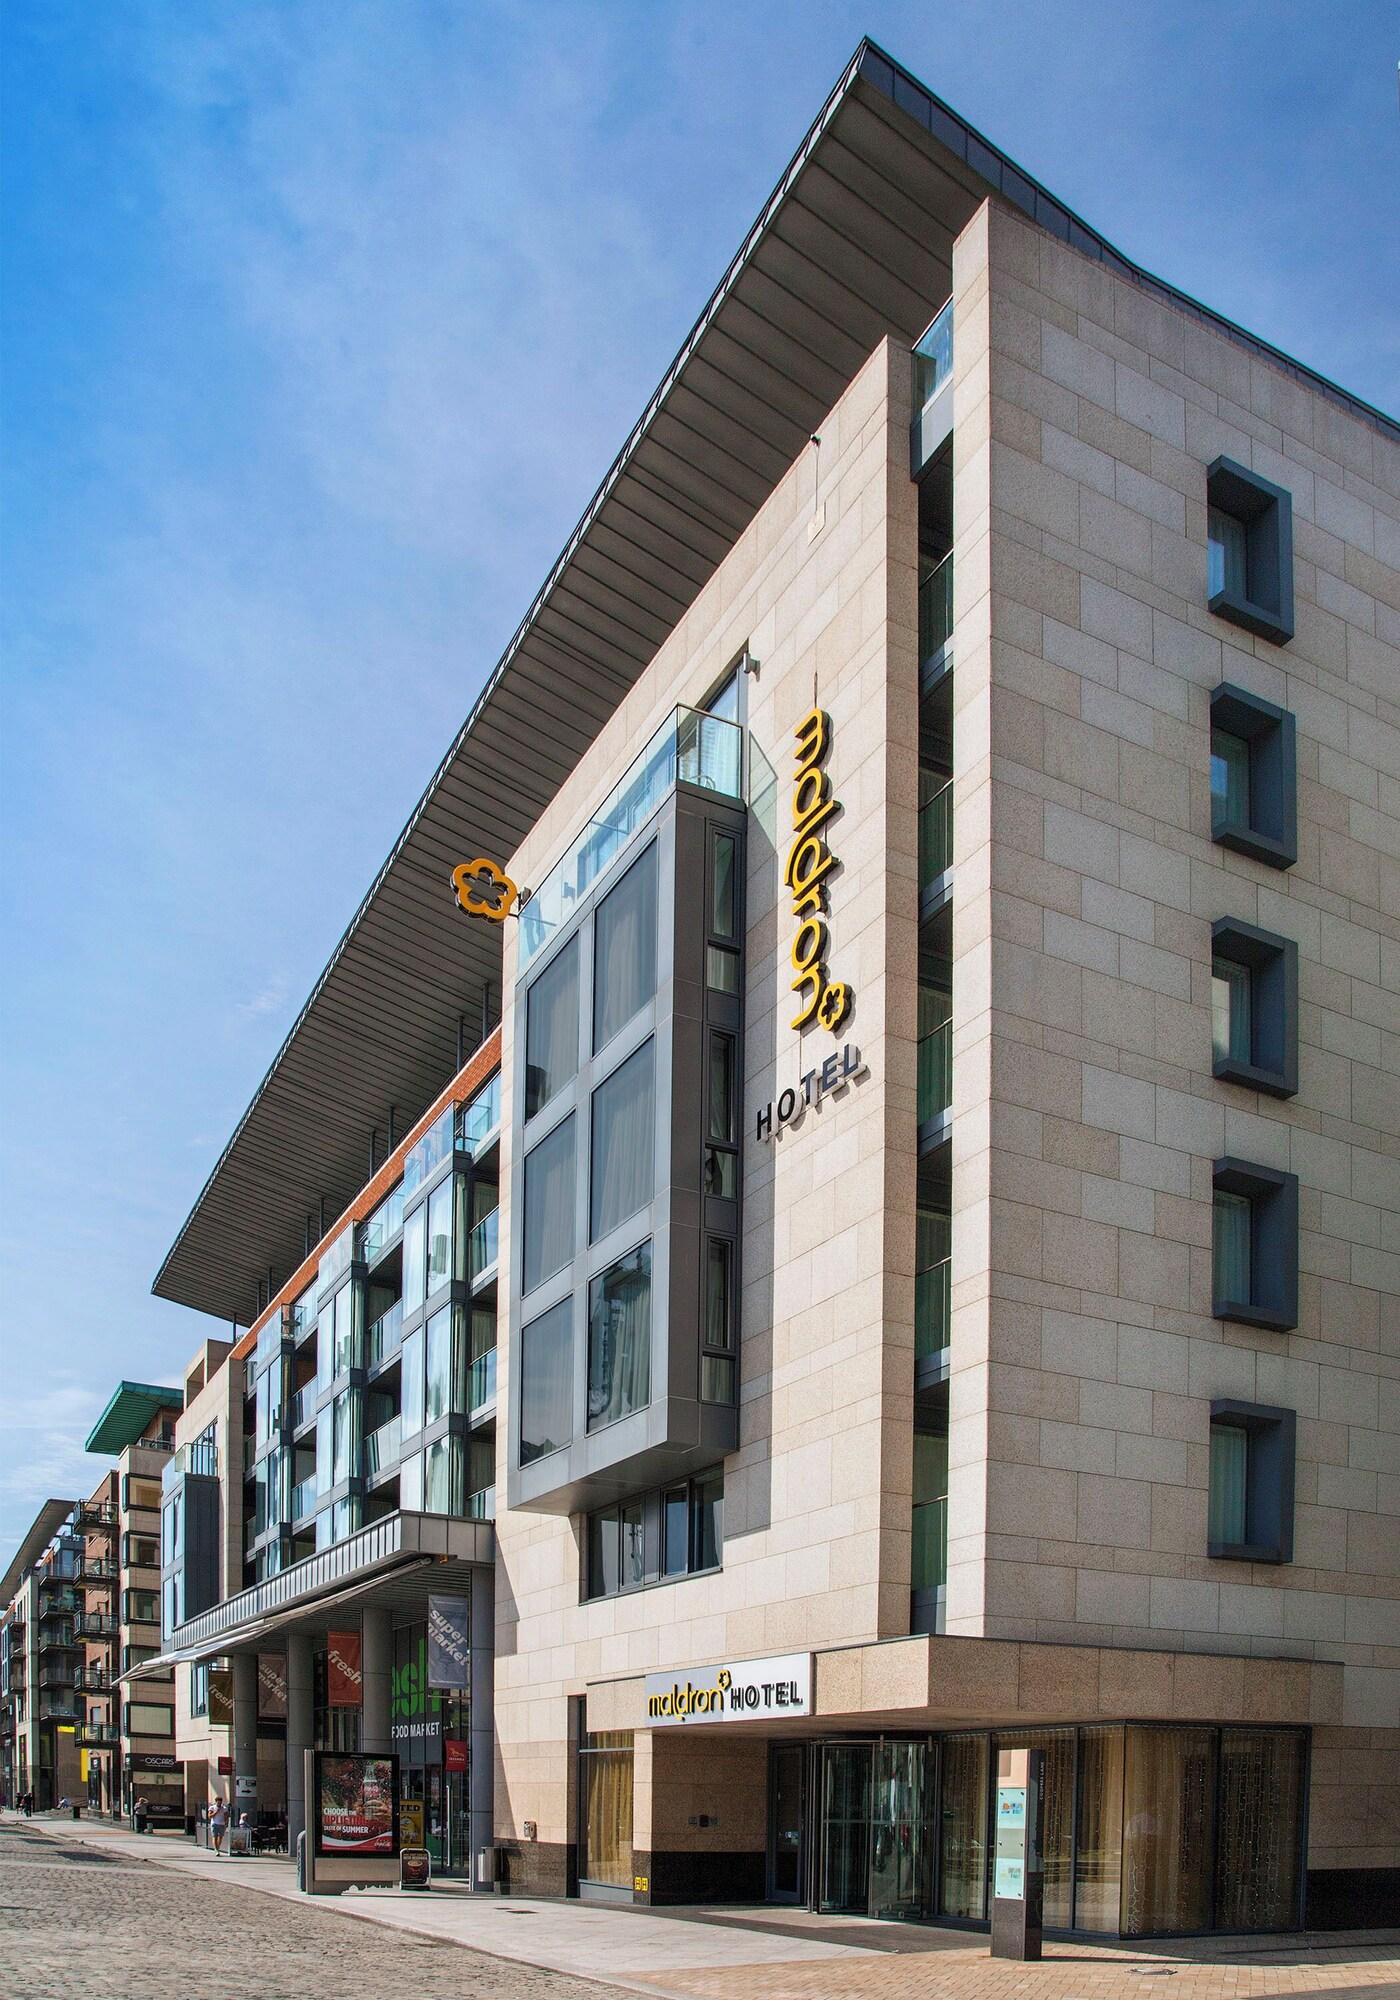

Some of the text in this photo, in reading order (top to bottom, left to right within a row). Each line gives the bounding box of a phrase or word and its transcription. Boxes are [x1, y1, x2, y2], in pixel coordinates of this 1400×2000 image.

[784, 708, 841, 1031] maldron
[757, 1043, 866, 1143] HOTEL
[430, 1609, 467, 1644] super
[428, 1622, 468, 1666] market
[259, 1663, 287, 1688] super
[328, 1650, 363, 1685] fresh
[208, 1684, 235, 1709] fresh
[258, 1671, 287, 1701] market
[648, 1680, 804, 1721] maldron HOTEL
[144, 1757, 175, 1766] OSCARS
[323, 1807, 348, 1816] CHOOSE
[342, 1826, 369, 1834] SUMMER
